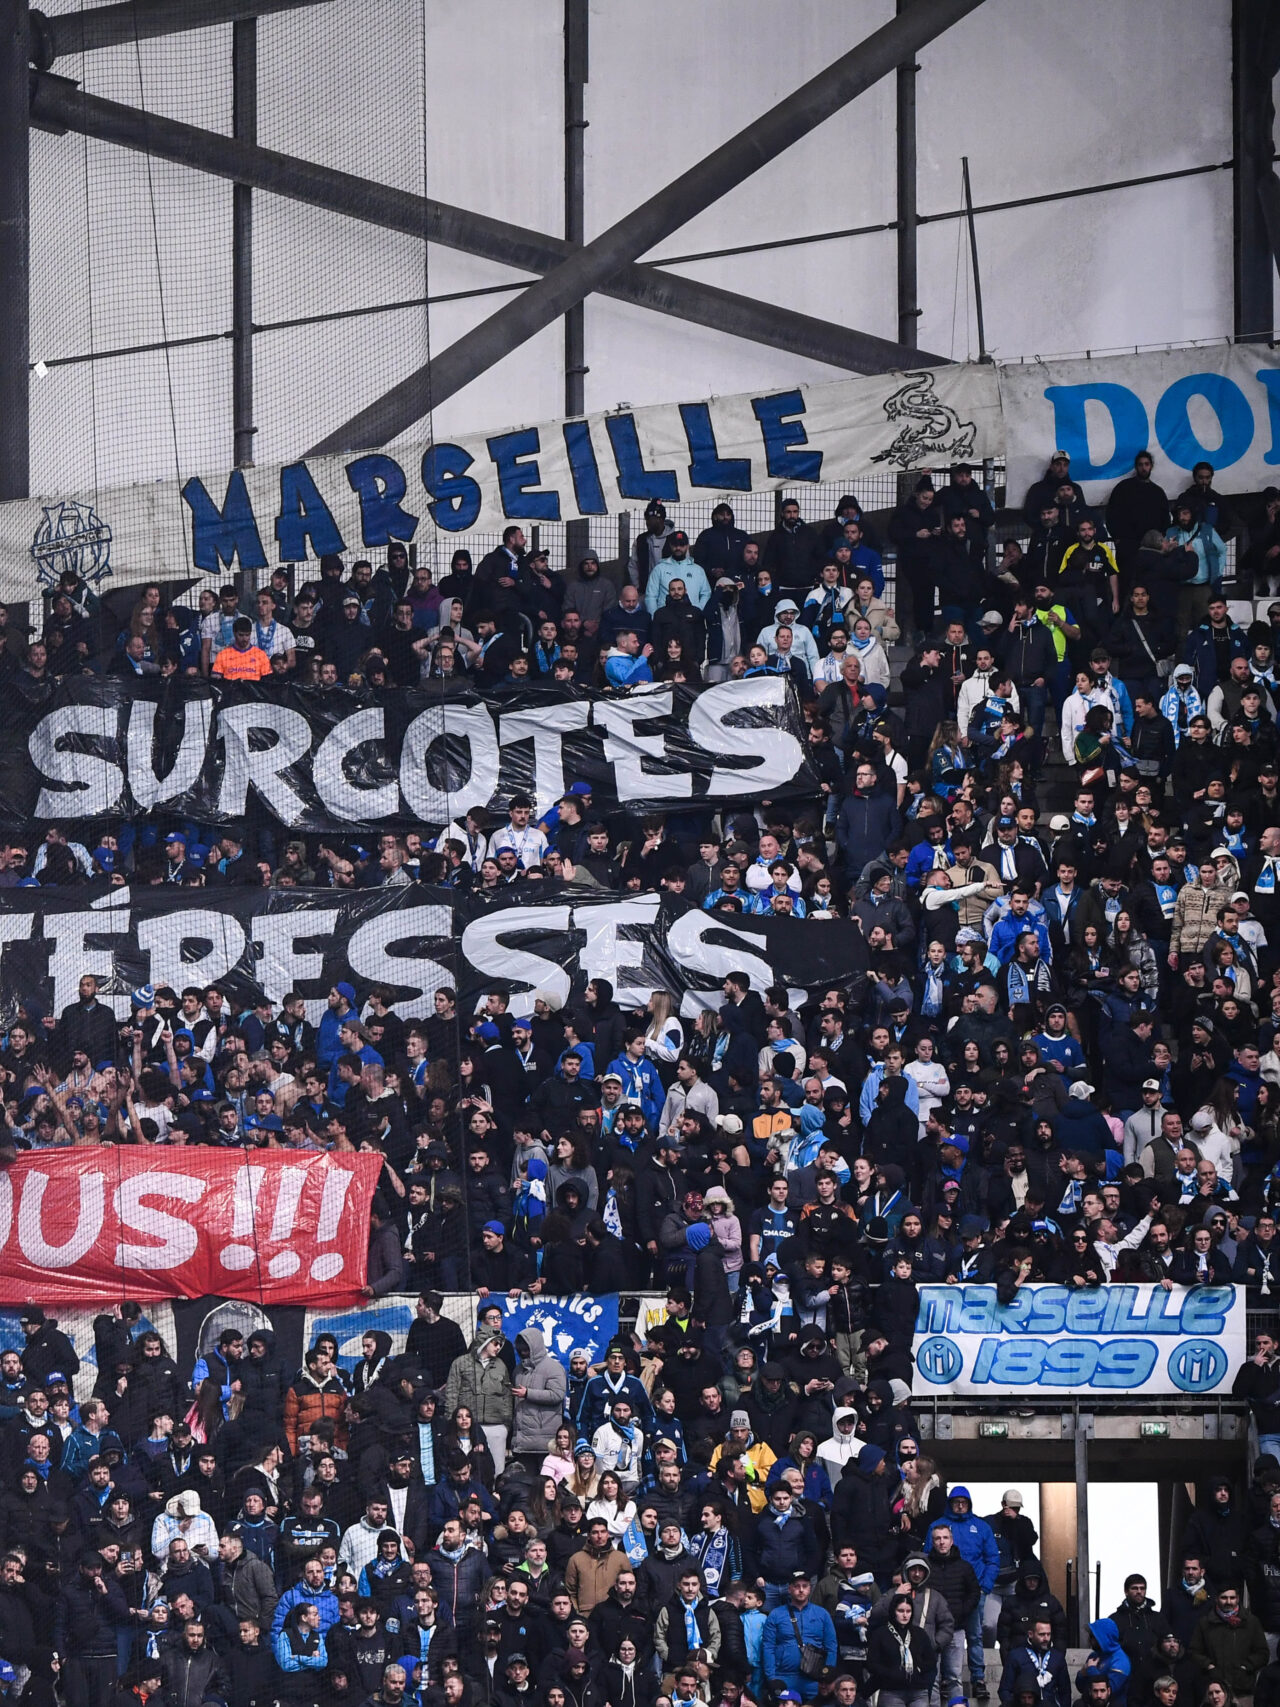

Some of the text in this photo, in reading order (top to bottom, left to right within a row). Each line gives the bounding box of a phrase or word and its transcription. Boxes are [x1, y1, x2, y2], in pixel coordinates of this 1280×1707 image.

[181, 389, 824, 575] MARSEILLE
[1044, 369, 1280, 482] DO
[970, 1338, 1159, 1389] 1899
